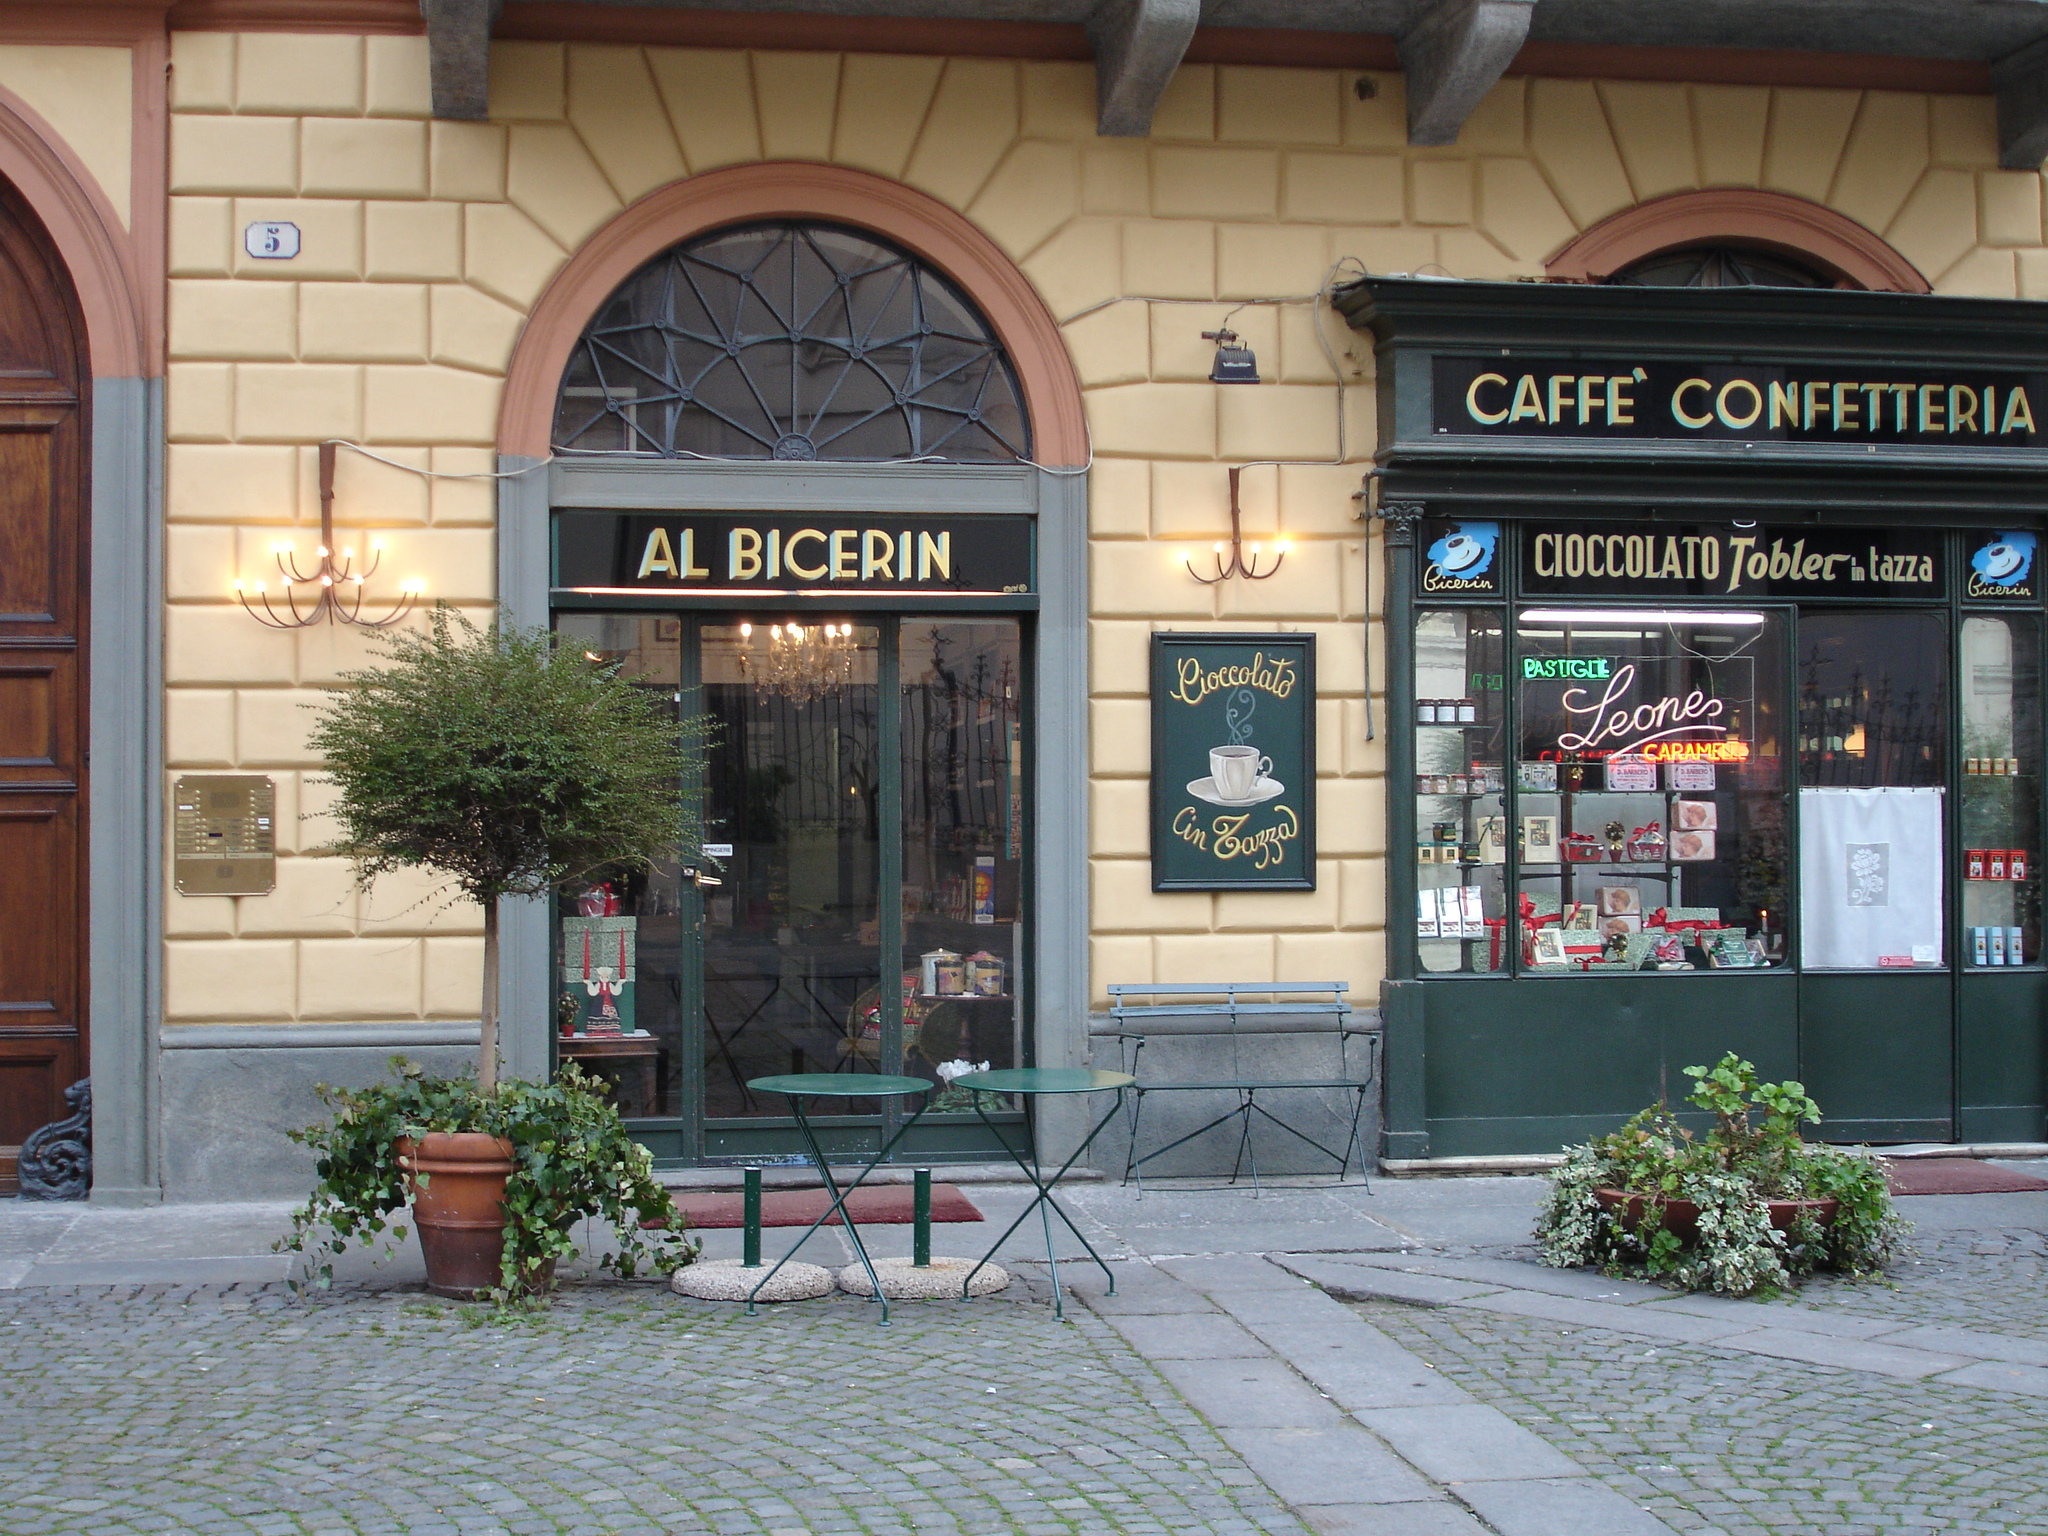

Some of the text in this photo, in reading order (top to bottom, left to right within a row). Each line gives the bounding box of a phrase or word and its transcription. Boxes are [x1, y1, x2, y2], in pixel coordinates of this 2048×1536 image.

[264, 227, 280, 253] 5
[1671, 378, 2036, 435] CONFETTERIA
[637, 527, 951, 582] AL BICERIN
[1534, 533, 1934, 593] CIOCCOLATO Tobler in tazza
[1424, 563, 1493, 591] Bicerin
[1968, 570, 2032, 597] Bicerin
[1524, 658, 1610, 678] PASTIGLIE
